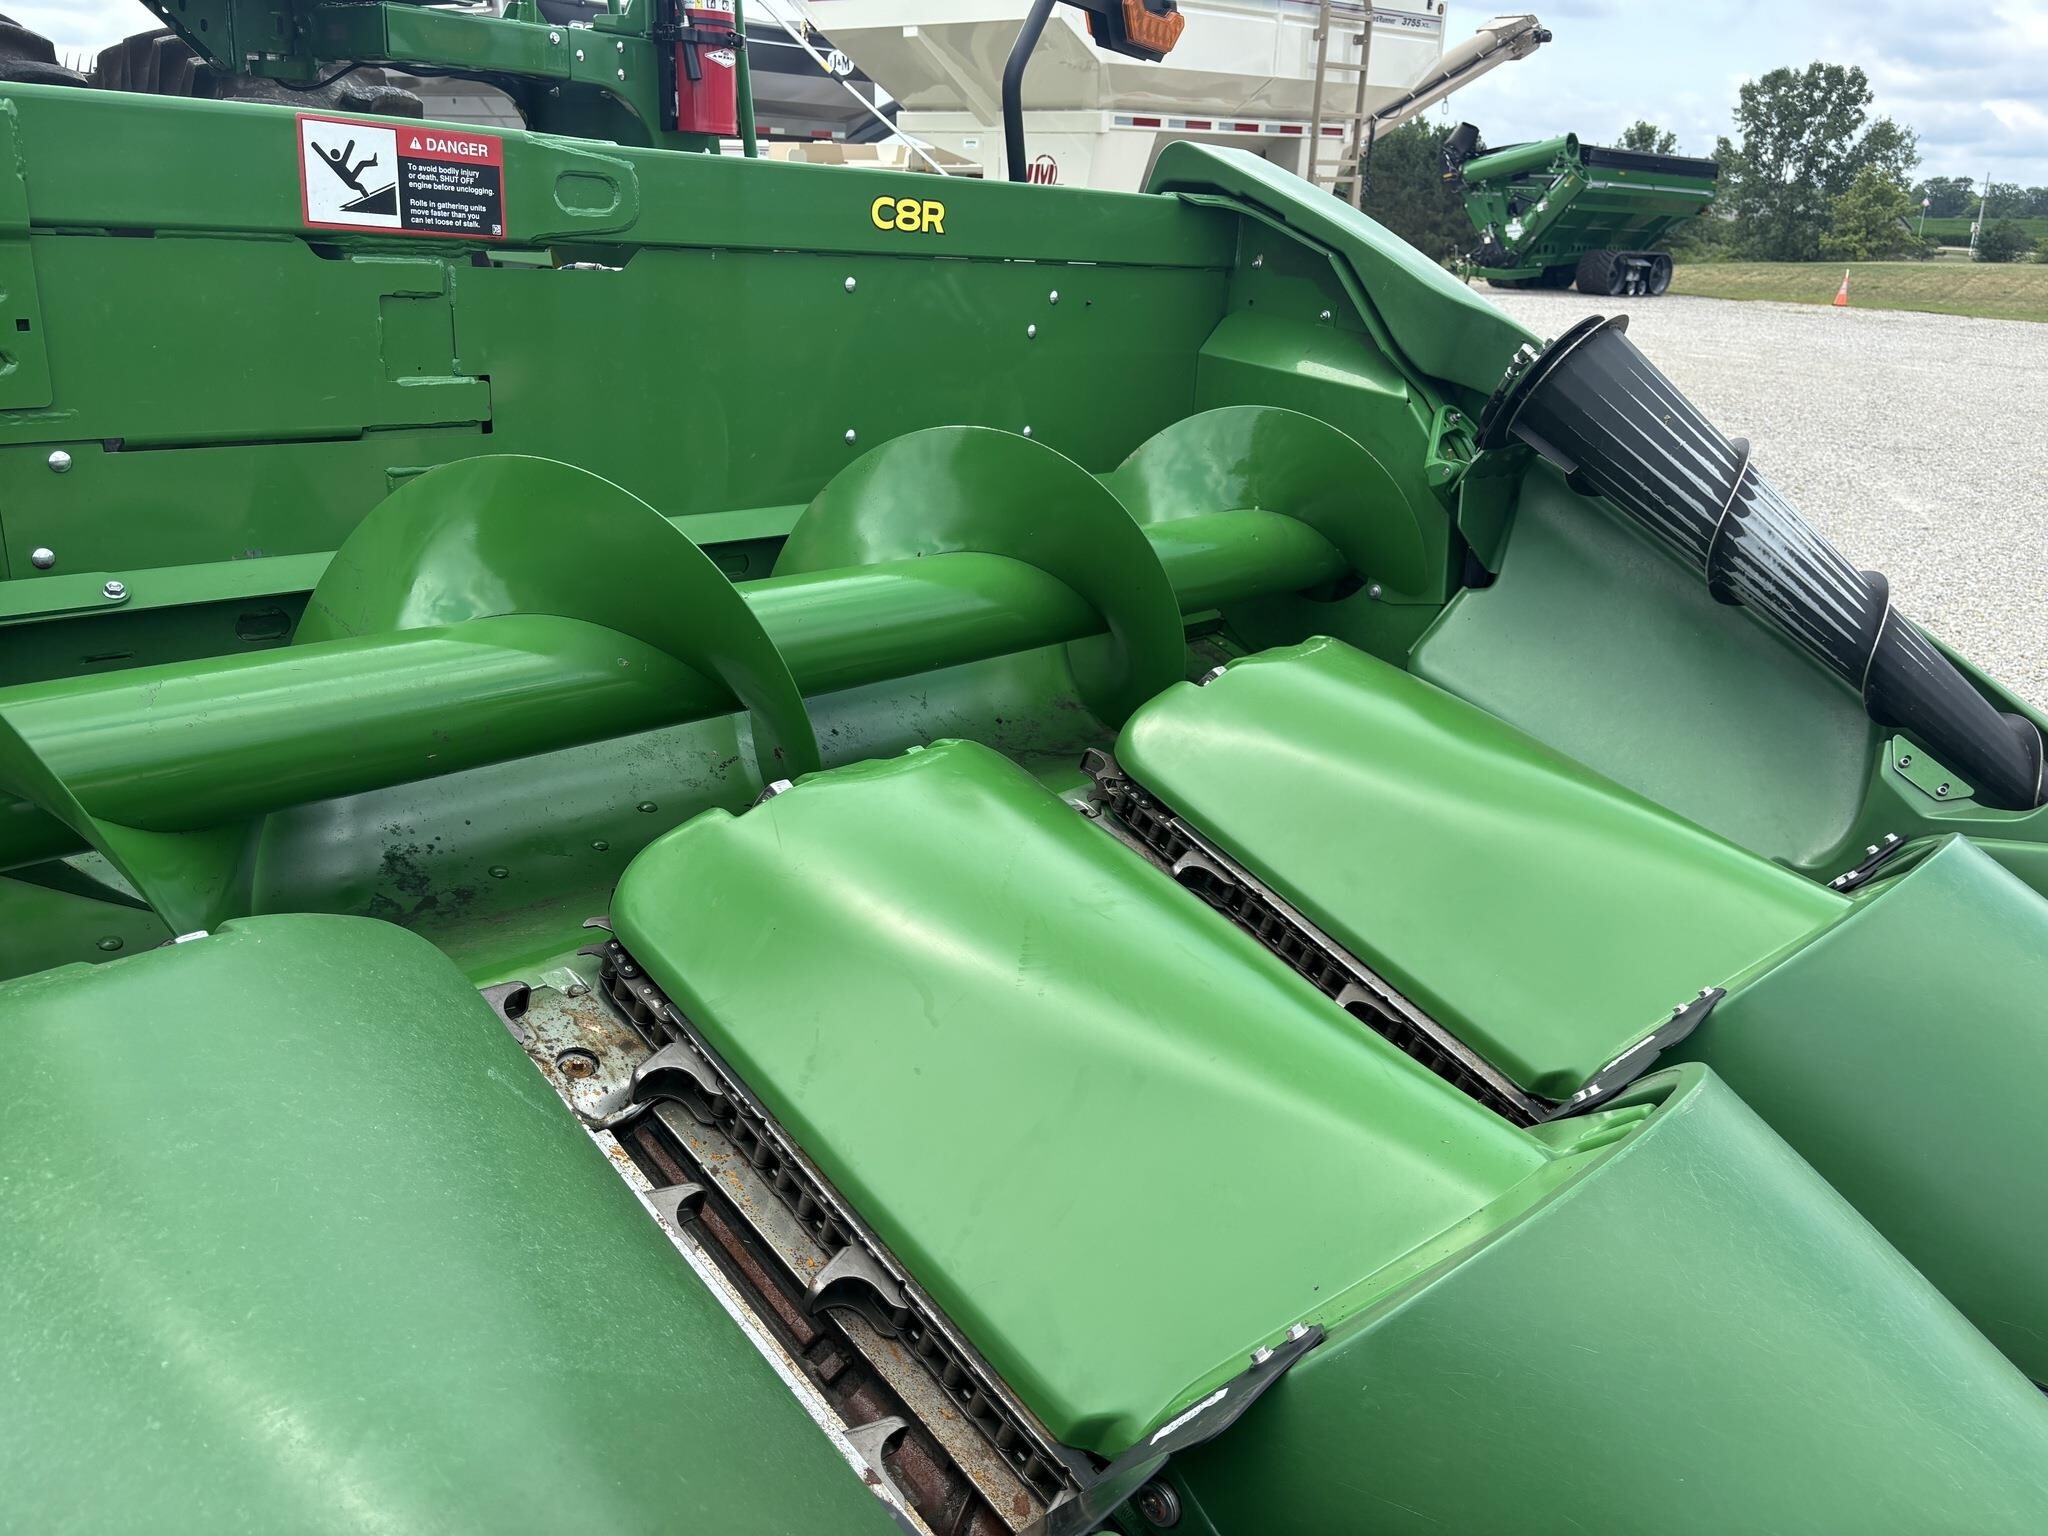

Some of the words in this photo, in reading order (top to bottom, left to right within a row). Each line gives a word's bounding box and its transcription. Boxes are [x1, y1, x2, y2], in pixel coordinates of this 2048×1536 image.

[1402, 17, 1421, 27] 3755
[426, 137, 488, 158] DANGER
[408, 163, 417, 171] To
[418, 164, 437, 173] avoid
[438, 166, 459, 176] bodily
[460, 168, 479, 178] injury
[417, 172, 438, 182] death,
[440, 175, 459, 184] SHUT
[460, 177, 474, 185] OFF
[408, 181, 432, 190] engine
[433, 182, 455, 191] before
[456, 184, 495, 197] unclogging.
[409, 198, 428, 207] Rolls
[429, 200, 436, 208] in
[437, 201, 469, 212] gathering
[470, 204, 486, 212] units
[410, 208, 429, 216] move
[430, 208, 450, 217] faster
[451, 210, 466, 219] than
[467, 212, 480, 221] you
[870, 195, 945, 235] C8R
[424, 216, 434, 224] let
[435, 217, 453, 226] loose
[454, 219, 462, 227] of
[463, 220, 481, 228] stalk.
